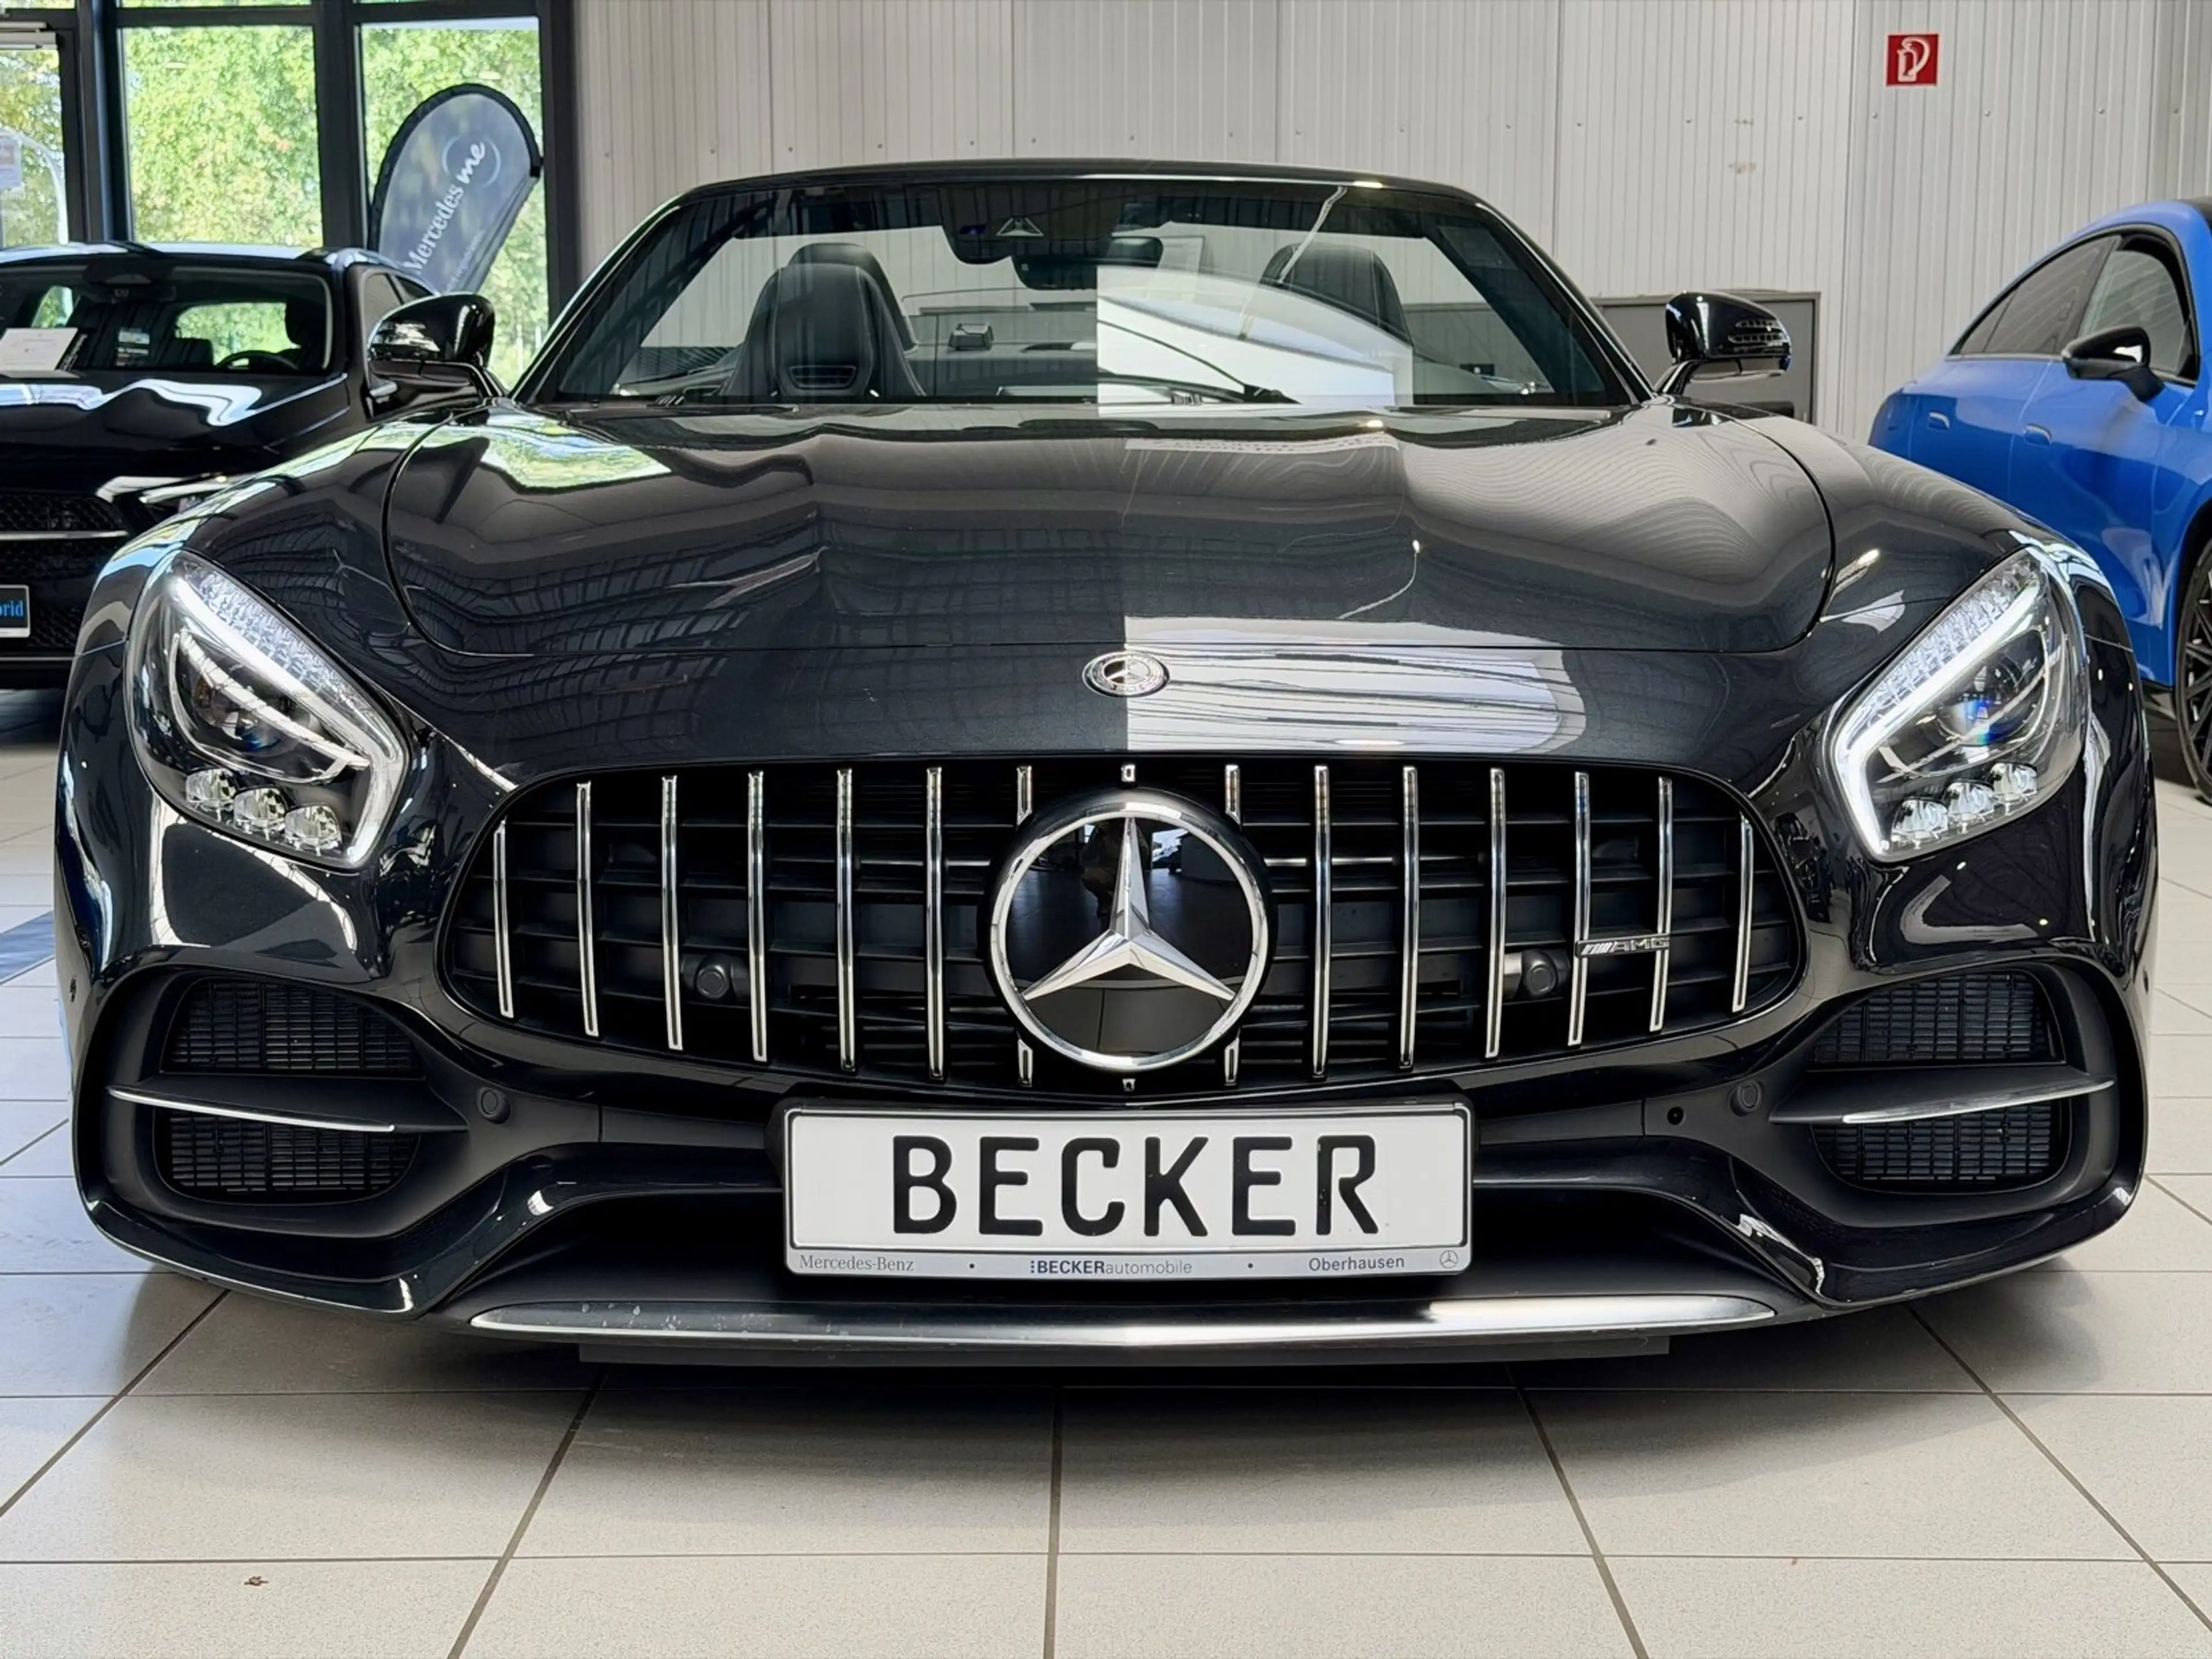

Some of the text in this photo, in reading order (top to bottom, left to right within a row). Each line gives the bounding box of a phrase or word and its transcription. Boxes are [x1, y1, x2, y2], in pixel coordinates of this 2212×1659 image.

[403, 183, 464, 274] Mercedes
[456, 142, 485, 184] me
[893, 1135, 1378, 1236] BECKER
[800, 1255, 914, 1271] Mercedes-Benz
[1309, 1256, 1404, 1272] Oberhausen
